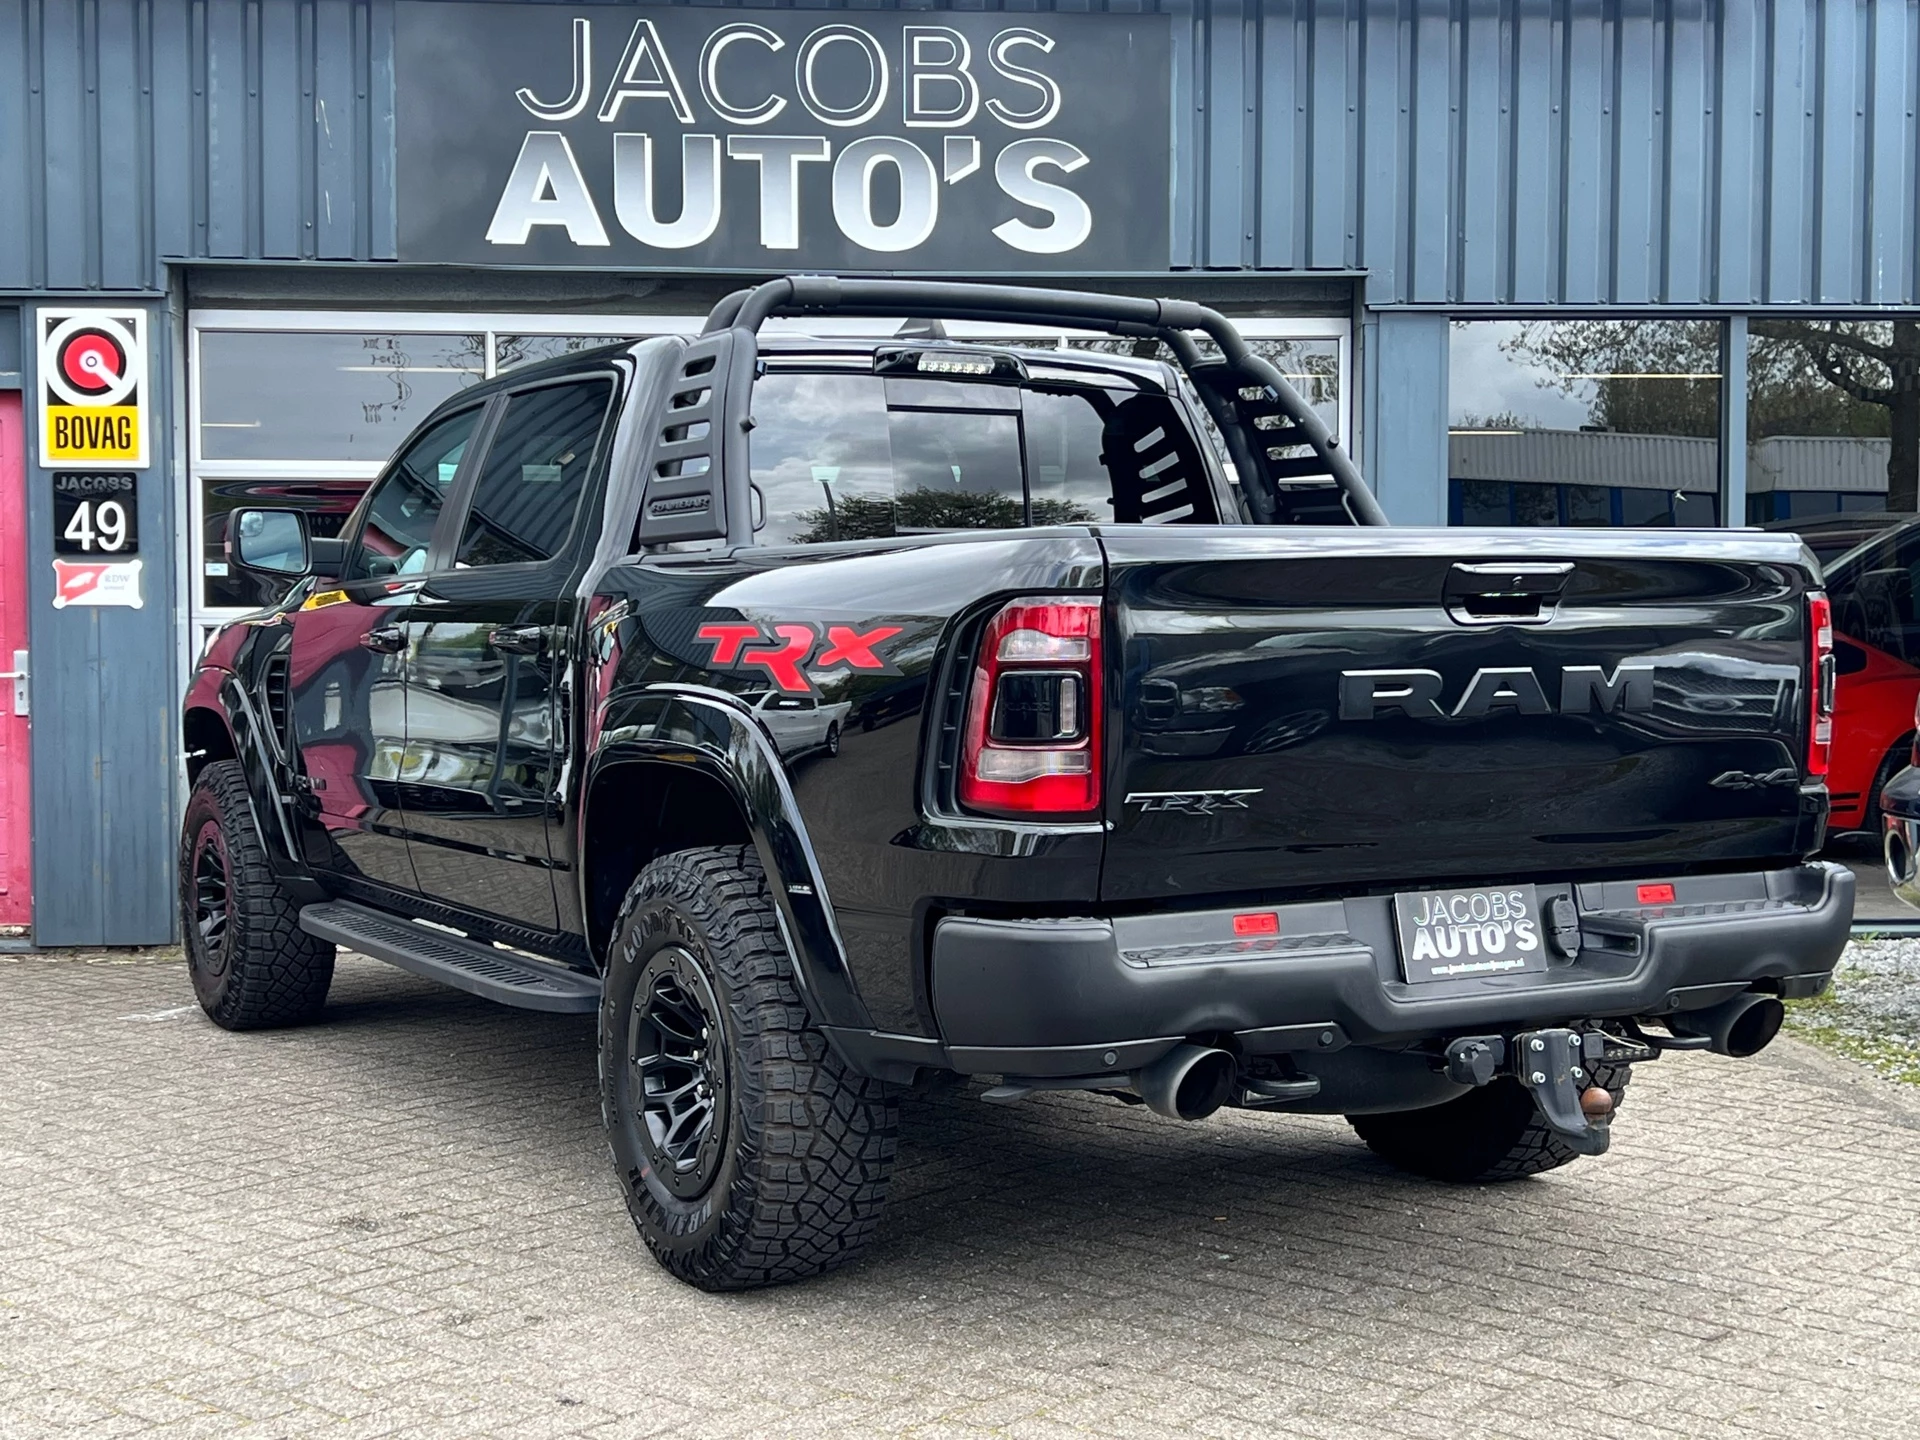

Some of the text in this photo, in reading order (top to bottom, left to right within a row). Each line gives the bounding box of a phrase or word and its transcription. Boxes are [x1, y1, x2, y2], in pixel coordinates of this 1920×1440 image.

[515, 18, 1062, 128] JACOBS
[485, 131, 1092, 253] AUTO'S
[55, 416, 131, 450] BOVAG
[64, 501, 126, 551] 49
[698, 625, 903, 693] TRX
[1340, 665, 1655, 719] RAM
[1124, 788, 1263, 815] TRX
[1413, 890, 1527, 926] JACOBS
[1412, 919, 1538, 960] AUTO'S
